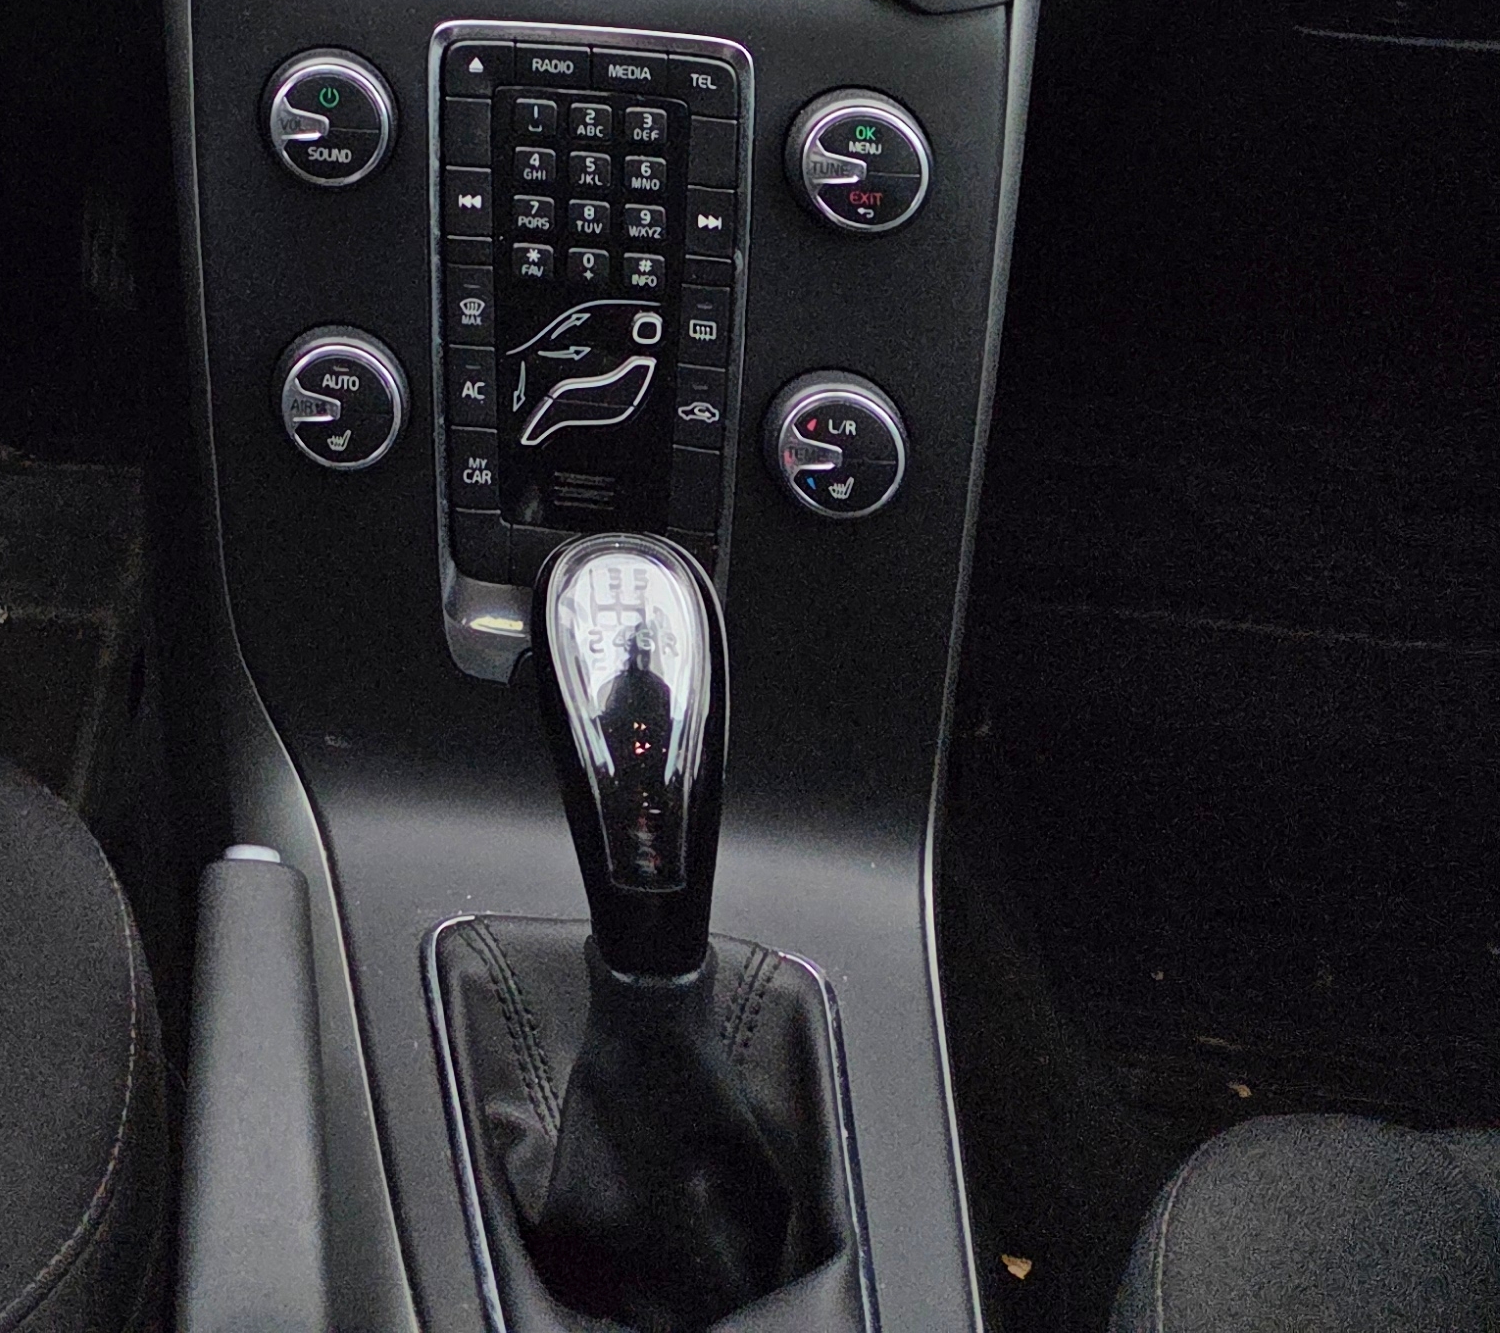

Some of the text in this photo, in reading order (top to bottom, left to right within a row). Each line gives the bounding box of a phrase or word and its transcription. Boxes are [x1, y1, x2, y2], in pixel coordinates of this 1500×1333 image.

[532, 58, 574, 75] RADIO
[608, 64, 651, 81] MEDIA
[690, 74, 717, 90] TEL
[533, 105, 539, 120] 1
[584, 110, 596, 124] 2
[642, 113, 653, 129] 3
[577, 125, 604, 139] ABC
[633, 129, 660, 142] DEF
[855, 126, 876, 141] OK
[307, 146, 352, 164] SOUND
[848, 141, 882, 155] MENU
[529, 153, 540, 168] 4
[585, 158, 596, 172] 5
[523, 168, 547, 182] GHI
[640, 163, 651, 177] 6
[578, 173, 604, 186] JKL
[631, 177, 660, 191] MNO
[850, 191, 883, 206] EXIT
[530, 201, 540, 215] 7
[583, 206, 595, 220] 8
[518, 216, 550, 231] PQRS
[640, 210, 651, 225] 9
[576, 220, 603, 234] TUV
[628, 226, 662, 240] WXYZ
[583, 253, 594, 269] 0
[521, 264, 544, 278] FAV
[631, 274, 657, 288] INFO
[461, 316, 482, 326] MAX
[322, 374, 360, 391] AUTO
[461, 381, 485, 400] AC
[828, 419, 857, 436] L/R
[468, 458, 488, 471] MY
[463, 470, 492, 485] CAR
